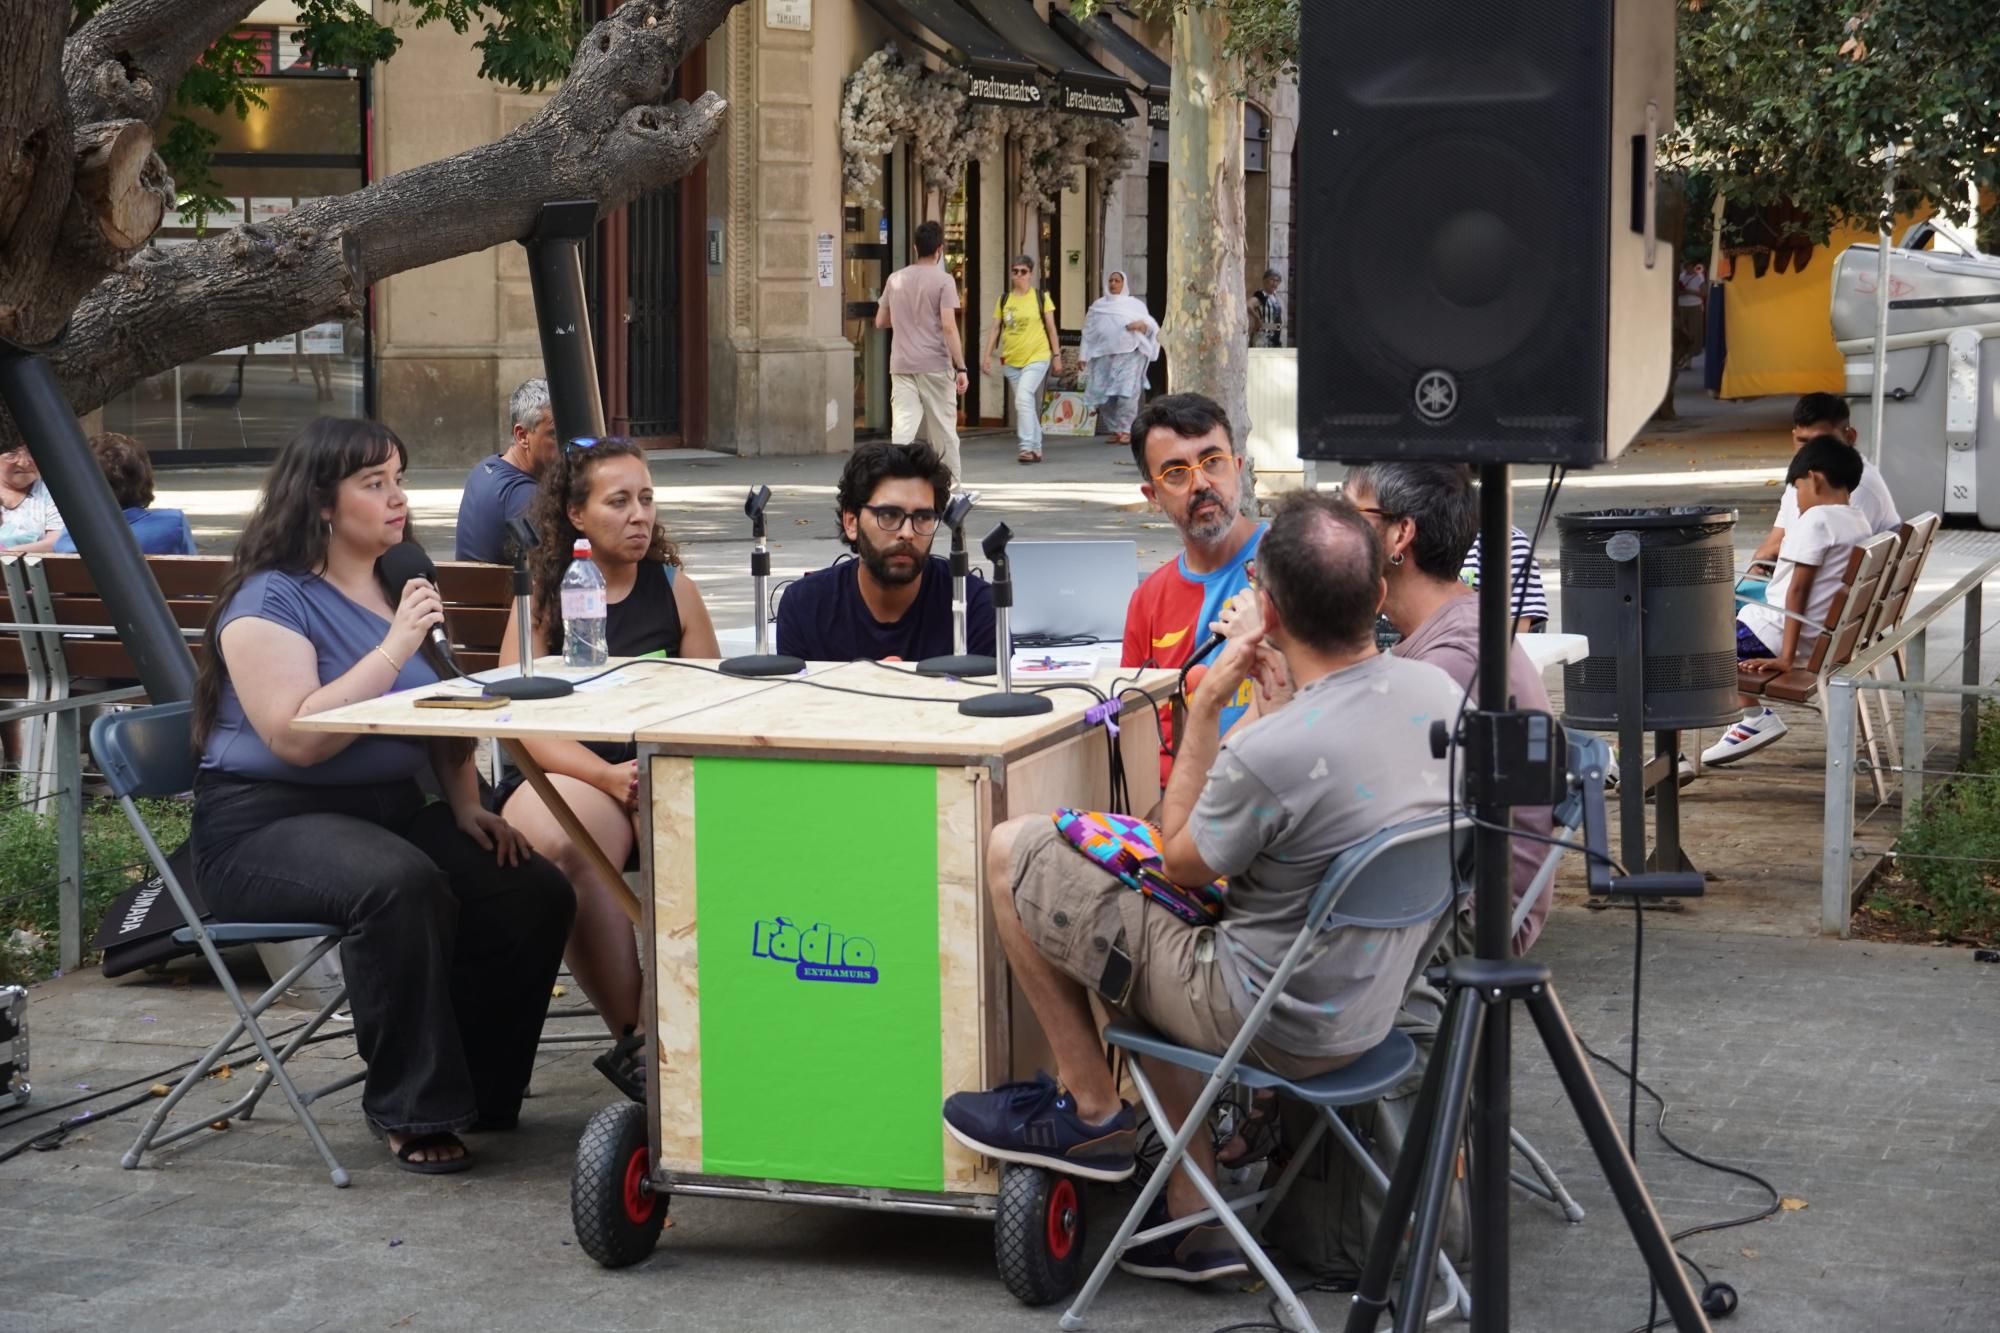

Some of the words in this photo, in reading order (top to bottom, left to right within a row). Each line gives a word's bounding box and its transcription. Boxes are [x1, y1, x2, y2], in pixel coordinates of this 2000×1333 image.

[776, 13, 802, 24] TAMARIT
[968, 74, 1041, 102] levaduramadre
[1065, 87, 1126, 114] levaduramadre
[119, 886, 164, 935] YAMAHA
[803, 967, 872, 980] EXTRAMURS
